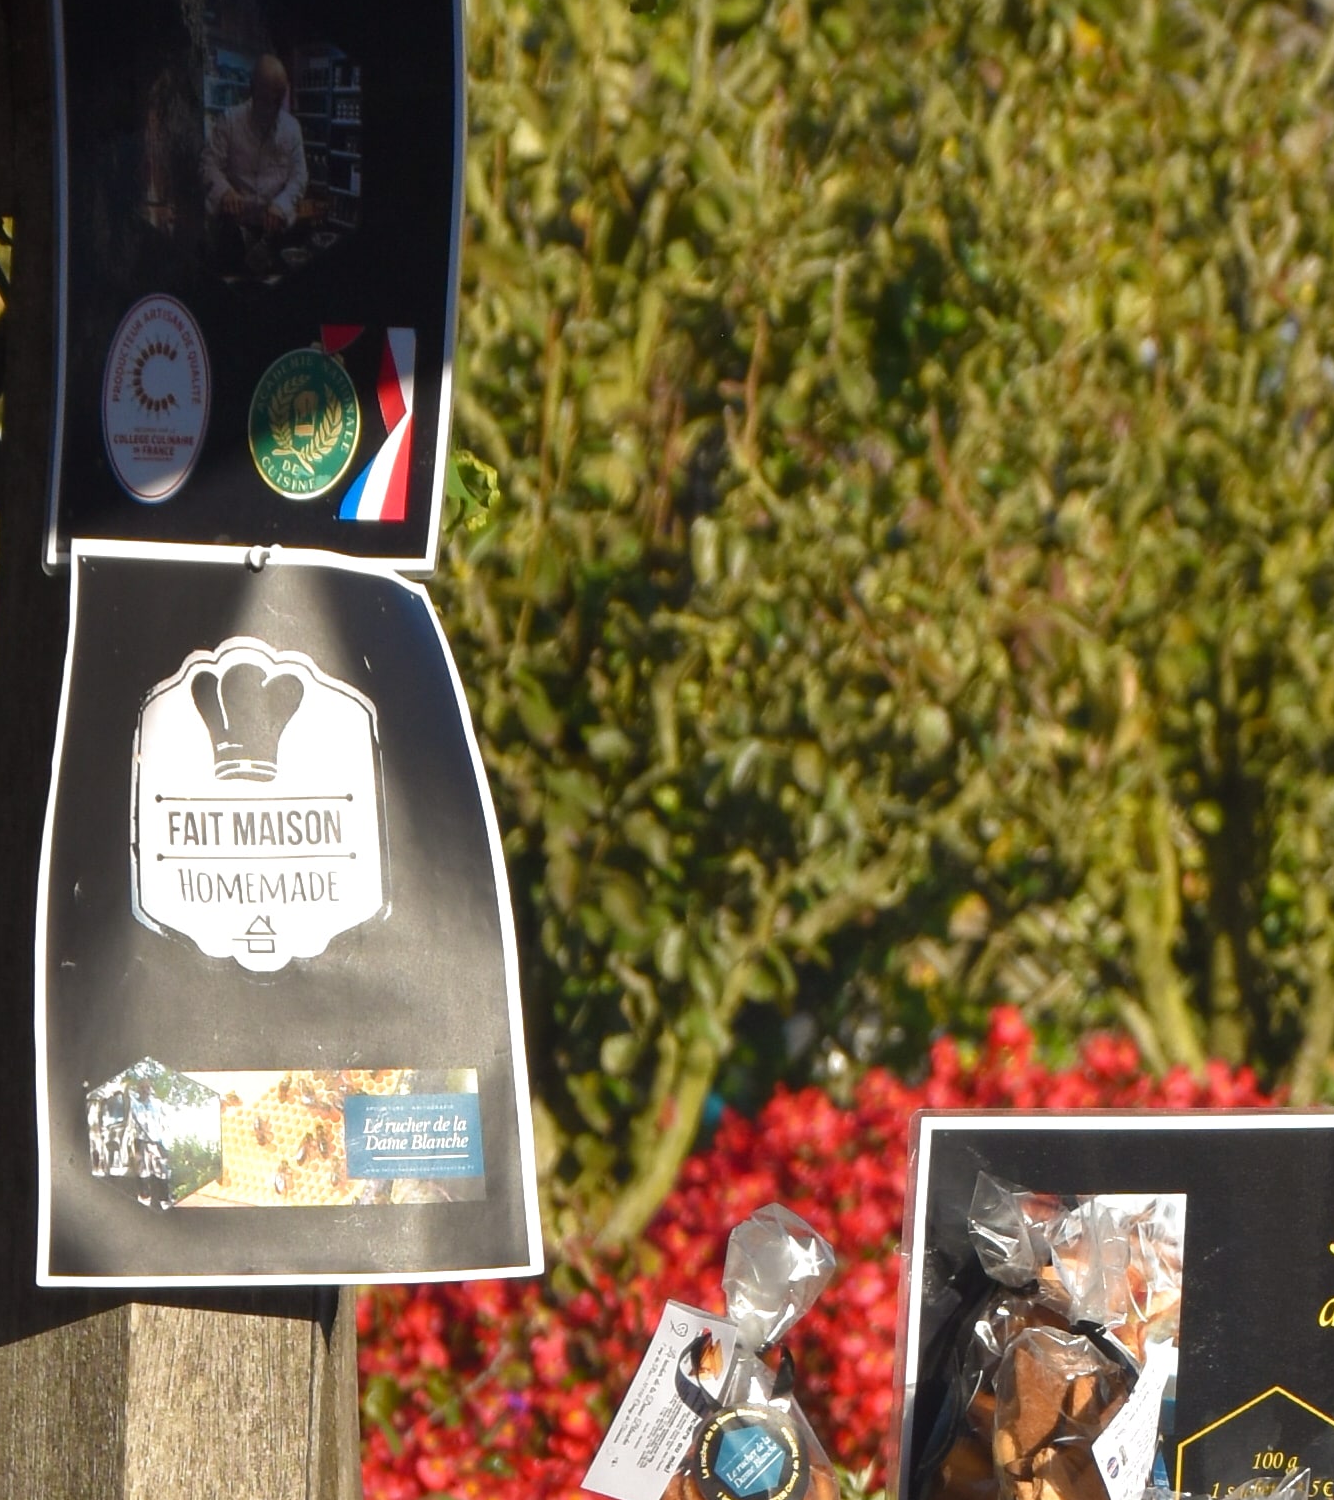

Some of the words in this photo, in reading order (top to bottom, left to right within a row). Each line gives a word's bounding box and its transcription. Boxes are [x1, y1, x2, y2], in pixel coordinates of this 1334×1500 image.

[281, 458, 301, 477] DE
[168, 809, 228, 847] FAIT
[233, 808, 344, 846] MAISON
[177, 866, 341, 905] HOMEMADE
[362, 1118, 383, 1135] Le
[384, 1115, 431, 1134] rucher
[432, 1115, 451, 1132] de
[452, 1114, 468, 1132] la
[365, 1134, 409, 1152] Dame
[410, 1131, 469, 1151] Blanche
[1251, 1451, 1284, 1470] 100
[1285, 1455, 1299, 1475] g
[1211, 1481, 1220, 1499] 1
